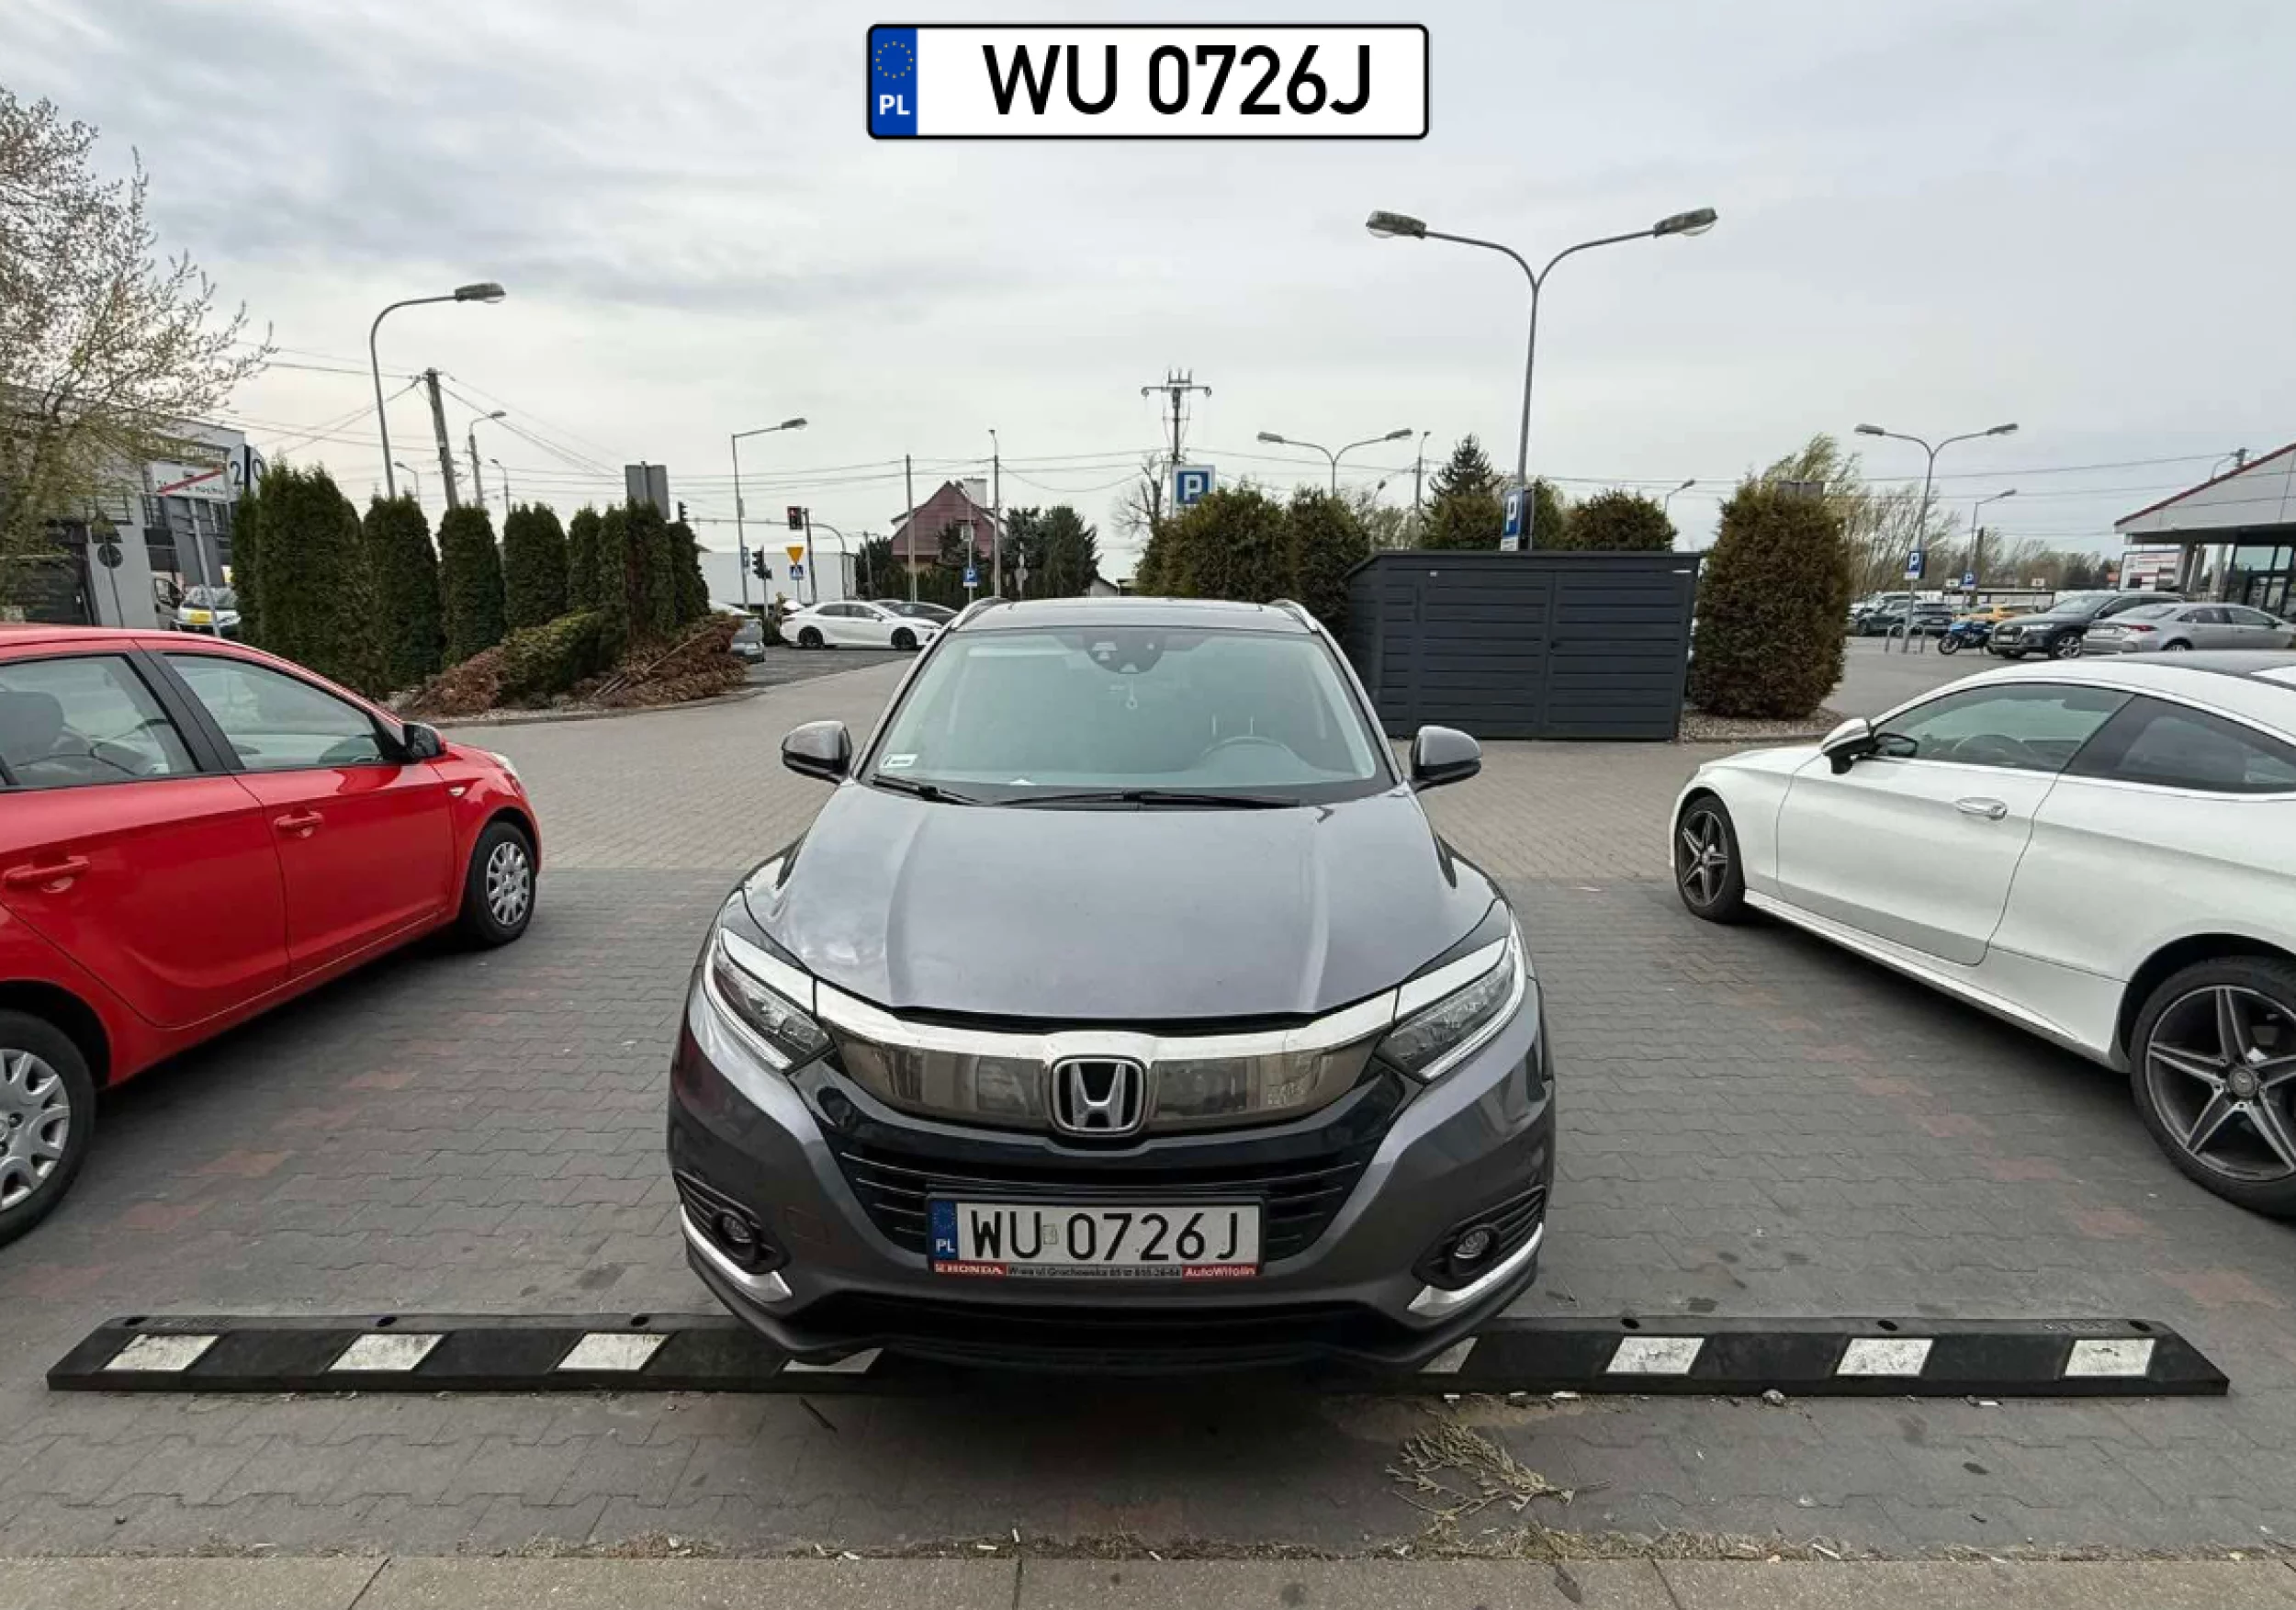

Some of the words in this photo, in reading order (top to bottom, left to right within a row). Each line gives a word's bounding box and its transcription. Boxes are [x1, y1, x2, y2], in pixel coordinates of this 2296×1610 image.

[1183, 474, 1203, 501] P
[1506, 494, 1518, 533] P
[1908, 552, 1919, 569] P
[970, 1210, 1042, 1260] WU
[1066, 1212, 1238, 1261] 0726J
[935, 1240, 956, 1253] PL
[946, 1264, 1003, 1275] HONDA
[1185, 1266, 1255, 1278] AutoWitolin
